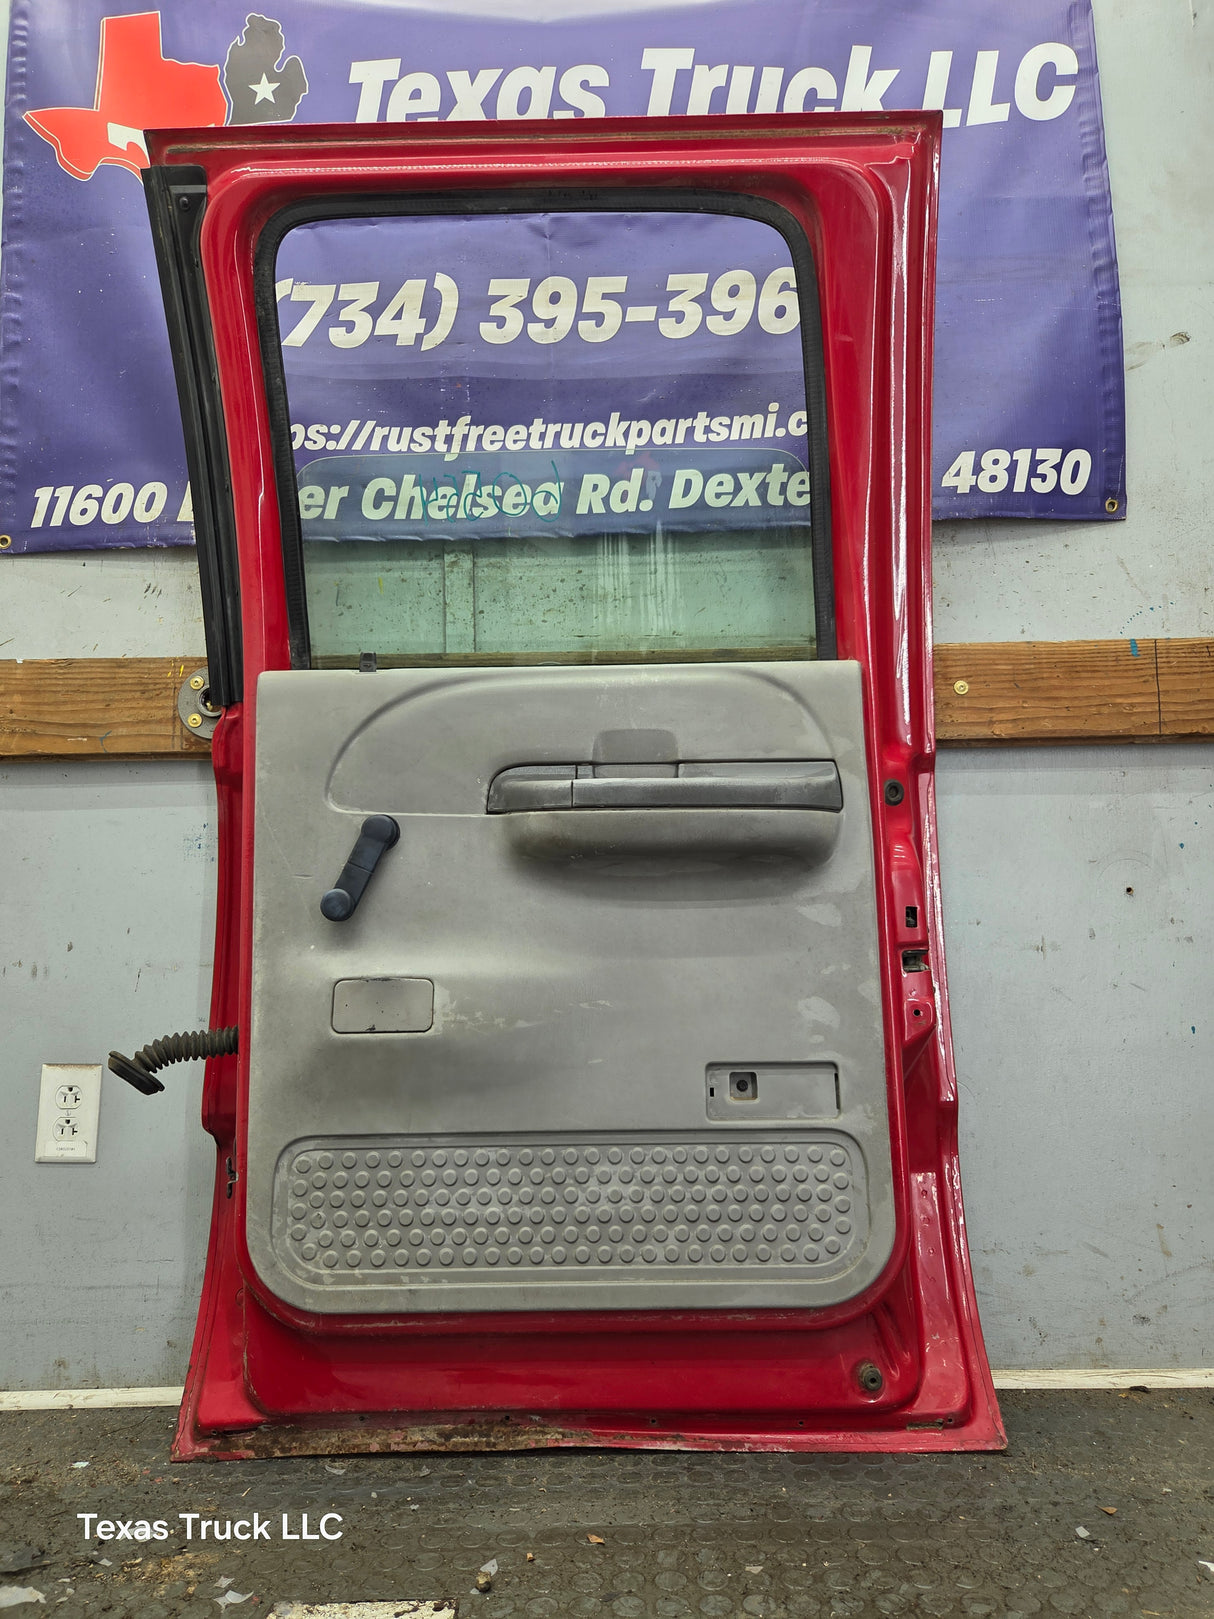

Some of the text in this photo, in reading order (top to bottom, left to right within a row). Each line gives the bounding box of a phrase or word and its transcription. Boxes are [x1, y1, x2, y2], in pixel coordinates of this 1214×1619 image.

[349, 41, 1079, 129] Texas Truck LLC
[30, 481, 168, 528] 11600
[361, 473, 565, 521] Chelsea
[575, 467, 654, 515] Rd.
[941, 448, 1092, 496] 48130
